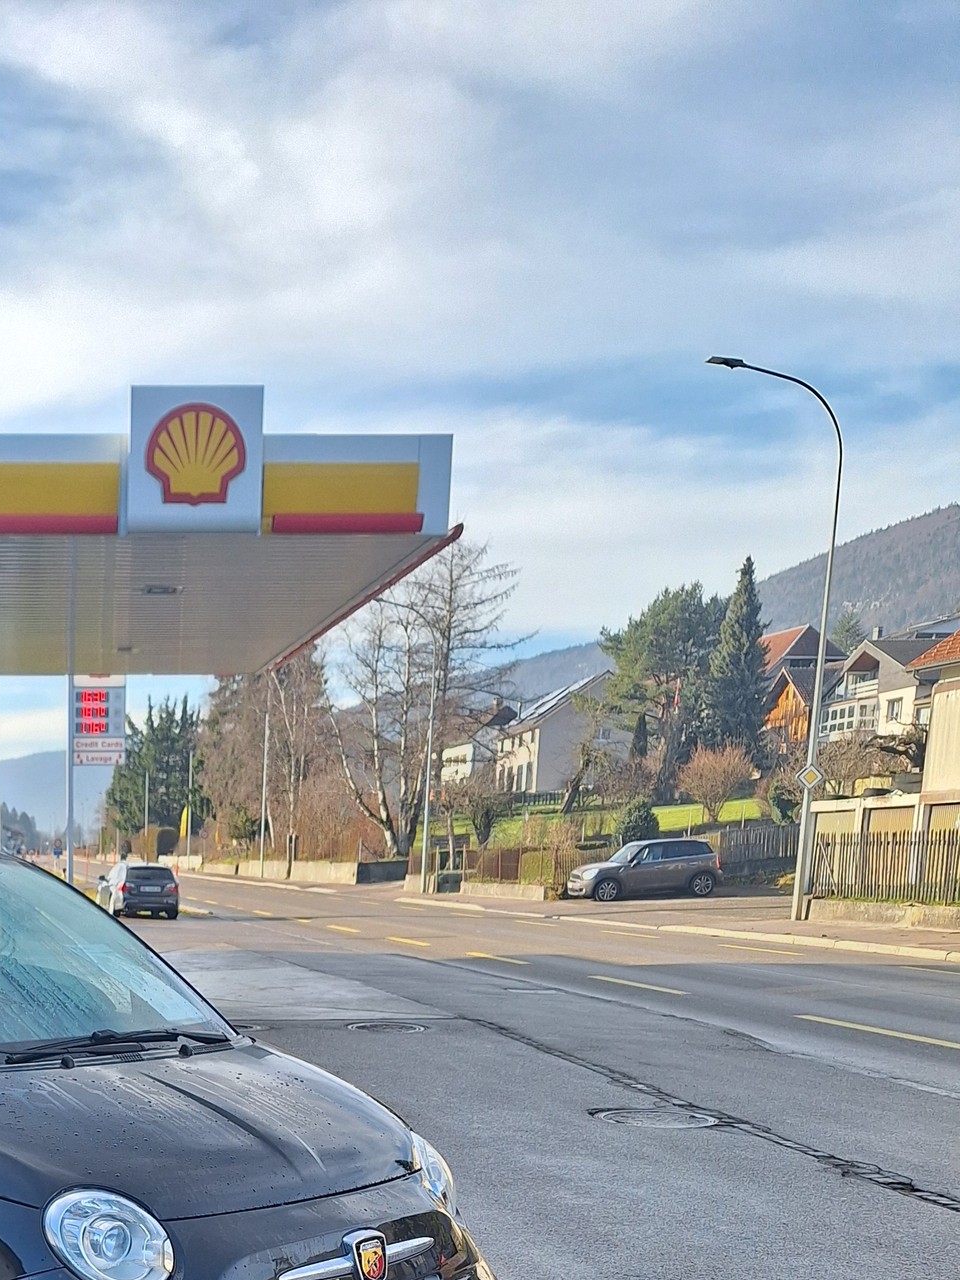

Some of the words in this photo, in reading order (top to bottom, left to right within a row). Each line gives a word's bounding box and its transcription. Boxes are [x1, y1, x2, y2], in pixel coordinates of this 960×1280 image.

[75, 741, 98, 749] Credit
[101, 741, 123, 749] Cards
[85, 754, 112, 764] Lavage
